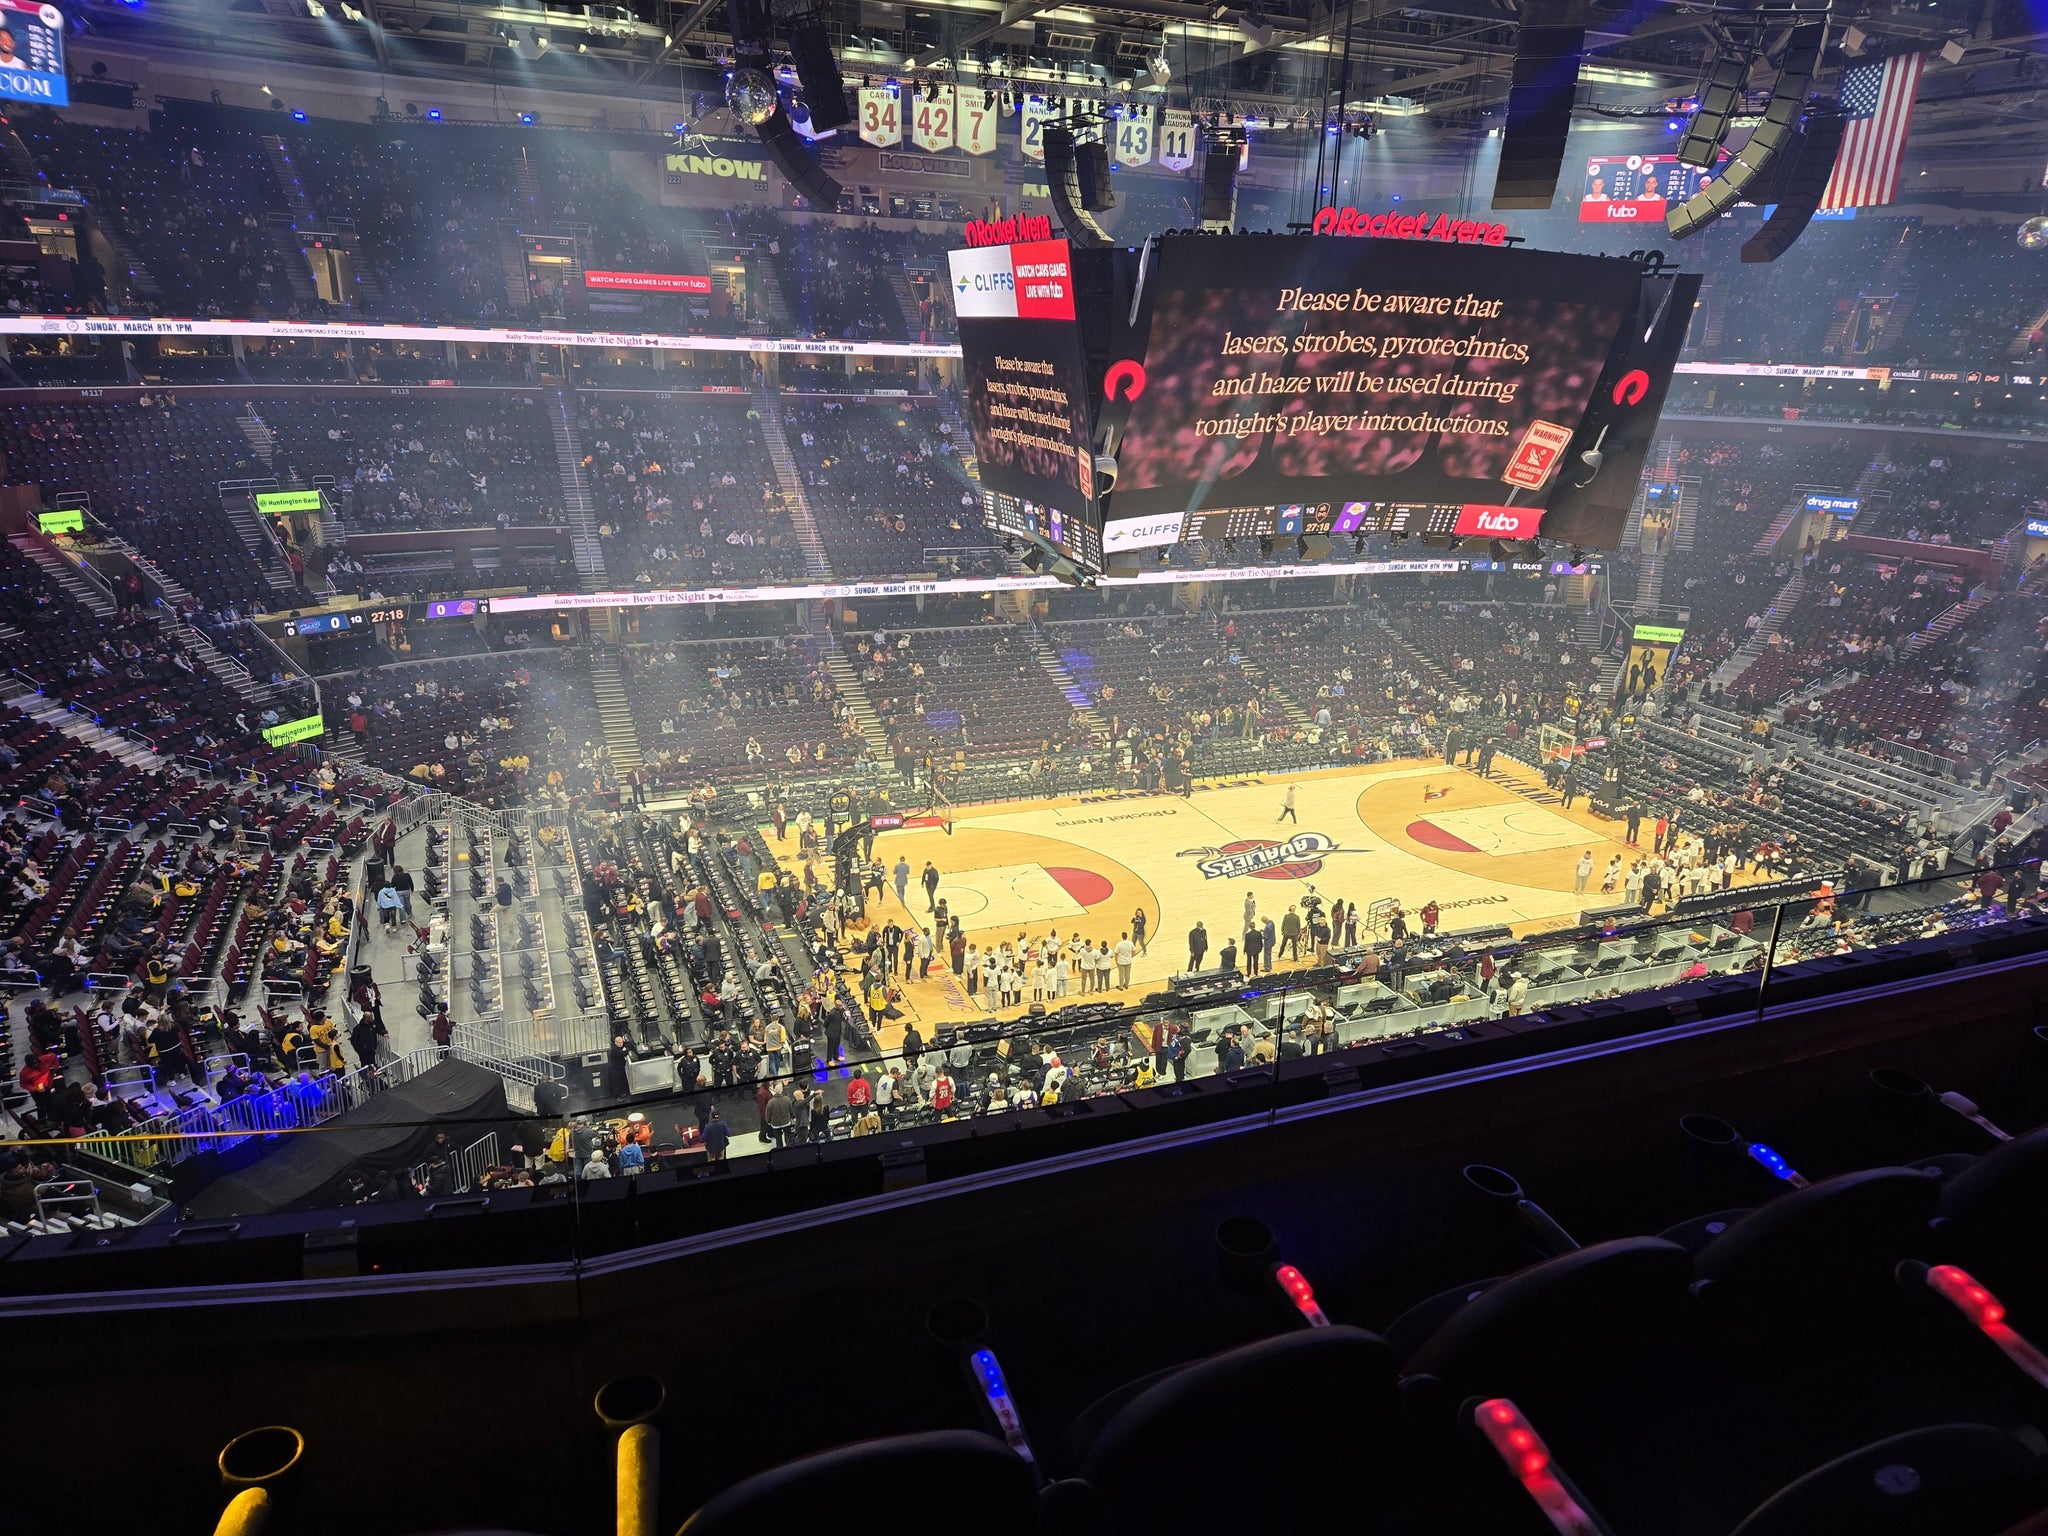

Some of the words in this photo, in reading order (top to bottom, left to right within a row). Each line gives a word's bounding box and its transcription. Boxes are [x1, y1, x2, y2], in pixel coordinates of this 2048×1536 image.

[864, 101, 897, 133] 34
[917, 106, 948, 138] 42
[970, 111, 984, 140] 7
[1119, 125, 1148, 155] 43
[1166, 131, 1188, 158] 11
[666, 154, 768, 181] KNOW.
[1607, 204, 1638, 218] fubo
[976, 214, 1018, 246] Rocket
[1019, 212, 1050, 241] Arena
[1336, 207, 1428, 239] Rocket
[1426, 212, 1507, 245] Arena
[1016, 264, 1035, 278] WATCH
[1048, 262, 1066, 276] GAMES
[590, 276, 614, 284] WATCH
[690, 280, 706, 288] fubo
[974, 271, 1014, 292] CLIFFS
[1276, 287, 1350, 312] Please
[1352, 288, 1381, 312] be
[1383, 293, 1452, 315] aware
[1453, 293, 1503, 319] that
[85, 322, 120, 332] SUNDAY,
[124, 322, 153, 332] MARCH
[157, 323, 172, 332] 8TH
[175, 323, 193, 333] 1PM
[576, 335, 597, 344] Bow
[599, 336, 615, 345] Tie
[616, 336, 642, 346] Night
[778, 342, 802, 352] SUNDAY,
[806, 344, 827, 352] MARCH
[842, 344, 854, 352] 1PM
[1221, 330, 1290, 358] lasers,
[1292, 330, 1378, 356] strobes,
[1379, 335, 1532, 366] pyrotechnics,
[994, 355, 1016, 371] Please
[1016, 356, 1024, 372] be
[1024, 361, 1042, 374] aware
[1041, 360, 1054, 376] that
[1930, 372, 1958, 381] $14,675
[2013, 376, 2032, 384] TOL
[986, 378, 1006, 396] lasers,
[1006, 382, 1030, 400] strobes,
[1029, 384, 1069, 407] pyrotechnics,
[1212, 371, 1254, 397] and
[1256, 372, 1311, 396] haze
[1316, 371, 1354, 393] will
[1356, 371, 1384, 394] be
[1387, 372, 1439, 396] used
[1441, 373, 1518, 404] during
[990, 403, 1002, 416] and
[1002, 404, 1018, 419] haze
[1017, 407, 1029, 421] will
[1029, 408, 1037, 423] be
[1036, 412, 1051, 426] used
[1050, 412, 1072, 434] during
[1194, 410, 1288, 439] tonight's
[1288, 410, 1358, 437] player
[1360, 410, 1511, 436] introductions.
[1533, 428, 1564, 444] WARNING
[1017, 430, 1036, 447] player
[1035, 434, 1076, 458] introductions.
[268, 498, 302, 507] Huntington
[303, 496, 319, 504] Bank
[1807, 497, 1832, 508] drug
[1832, 499, 1859, 510] mart
[1305, 506, 1315, 514] 1Q
[1286, 521, 1294, 532] 0
[1305, 522, 1330, 532] 27:18
[1342, 519, 1351, 530] 0
[1476, 511, 1519, 531] fubo
[1132, 524, 1180, 538] CLIFFS
[1388, 563, 1406, 571] SUNDAY,
[1410, 562, 1428, 570] MARCH
[1442, 561, 1454, 569] 1PM
[1492, 562, 1498, 570] 0
[1512, 562, 1543, 570] BLOCKS
[1556, 564, 1563, 572] 0
[1248, 570, 1260, 578] Tie
[1260, 569, 1282, 578] Night
[854, 584, 881, 595] SUNDAY,
[883, 584, 906, 593] MARCH
[908, 584, 921, 592] 8TH
[923, 584, 936, 592] 1PM
[596, 596, 628, 604] Giveaway
[633, 594, 656, 603] Bow
[657, 593, 675, 603] Tie
[677, 592, 706, 604] Night
[436, 604, 446, 616] 0
[350, 615, 363, 624] 1Q
[371, 610, 404, 623] 27:18
[330, 617, 340, 629] 0
[287, 628, 294, 636] 0
[307, 722, 322, 730] Bank
[1106, 810, 1162, 822] Rocket
[1056, 818, 1104, 827] Arena
[1200, 832, 1334, 878] CAVALIERS
[881, 1082, 888, 1091] 4
[939, 1089, 948, 1099] 23
